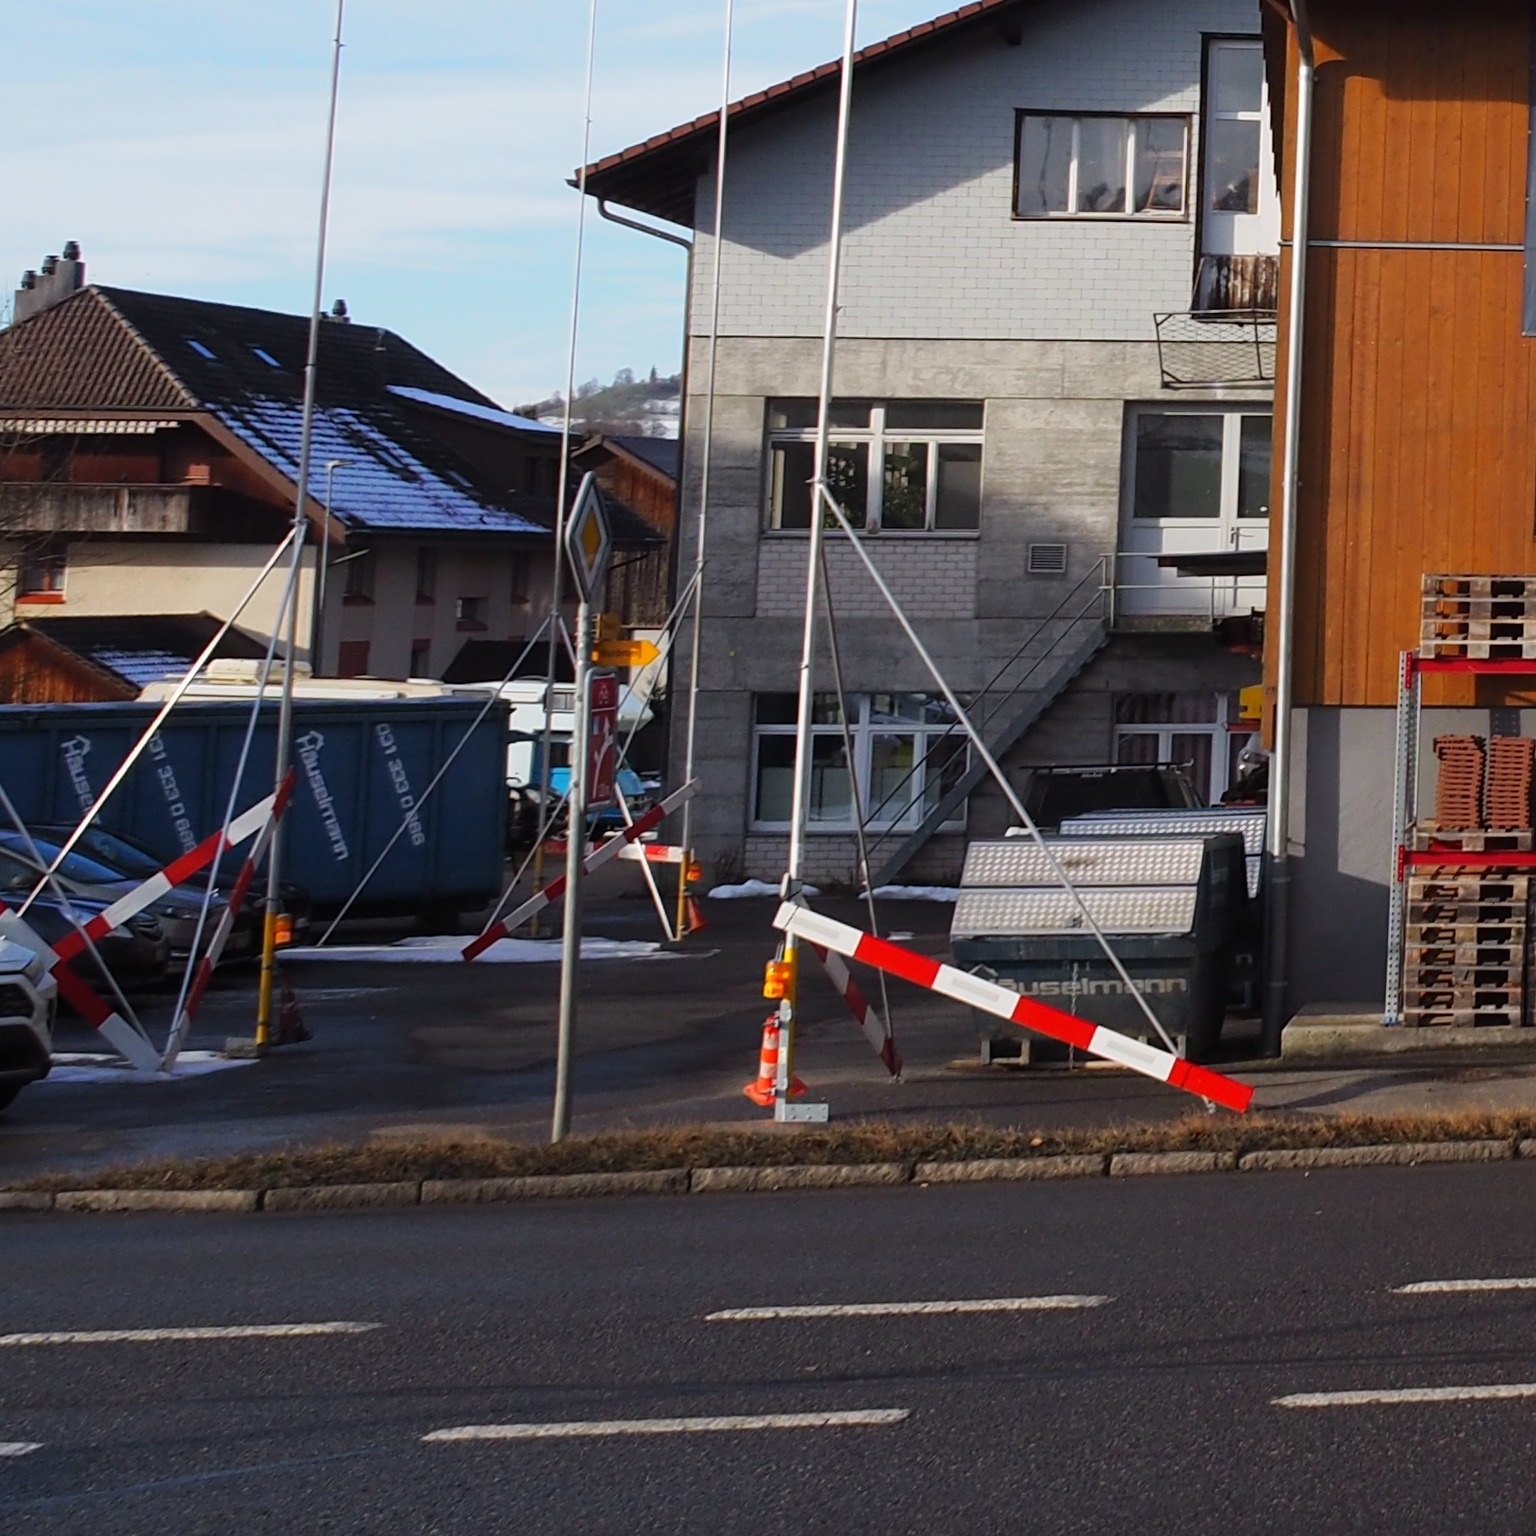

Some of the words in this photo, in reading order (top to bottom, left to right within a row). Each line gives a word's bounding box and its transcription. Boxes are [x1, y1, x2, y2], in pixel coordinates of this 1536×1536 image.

[375, 723, 398, 755] 031
[388, 759, 410, 795] 333
[158, 765, 181, 801] 333
[992, 975, 1187, 997] äuselmann
